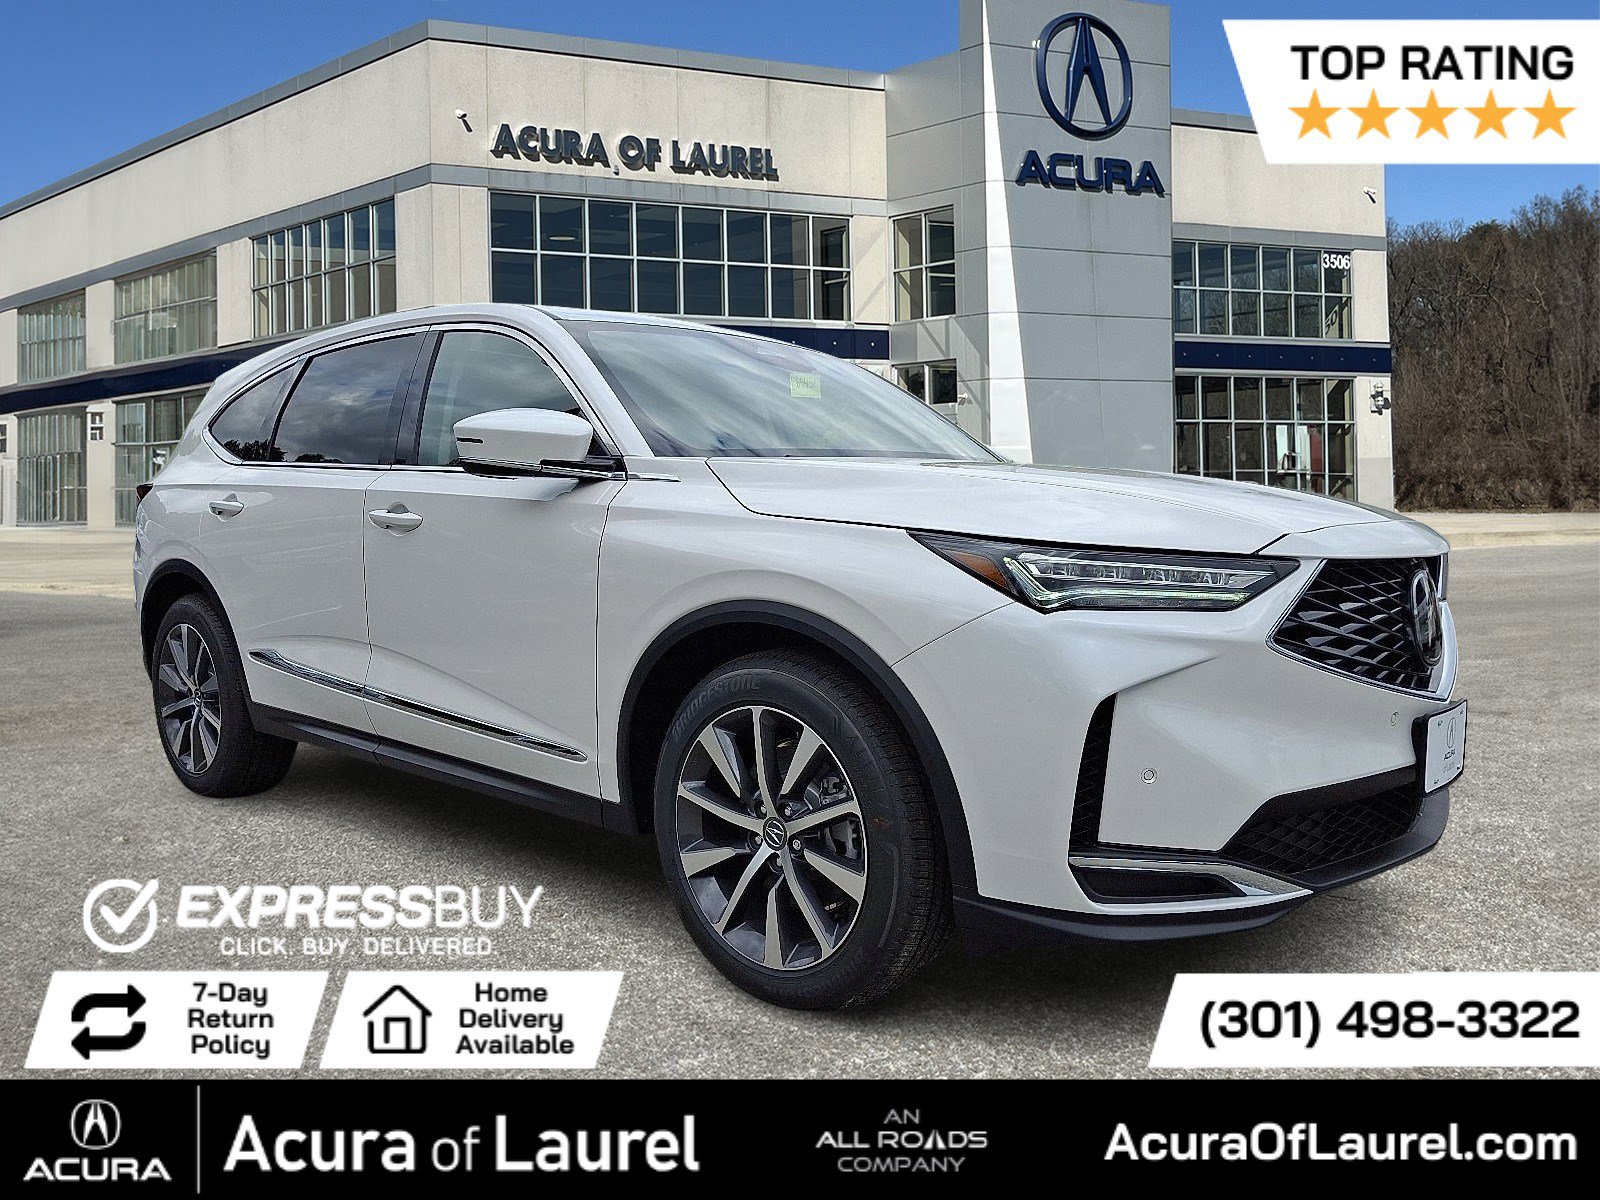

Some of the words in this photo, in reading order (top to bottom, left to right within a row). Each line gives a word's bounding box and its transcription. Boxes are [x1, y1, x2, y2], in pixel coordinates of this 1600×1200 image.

[490, 123, 611, 168] ACURA
[617, 135, 664, 171] OF
[669, 139, 779, 181] LAUREL
[1015, 150, 1165, 197] ACURA
[1322, 253, 1351, 270] 3506
